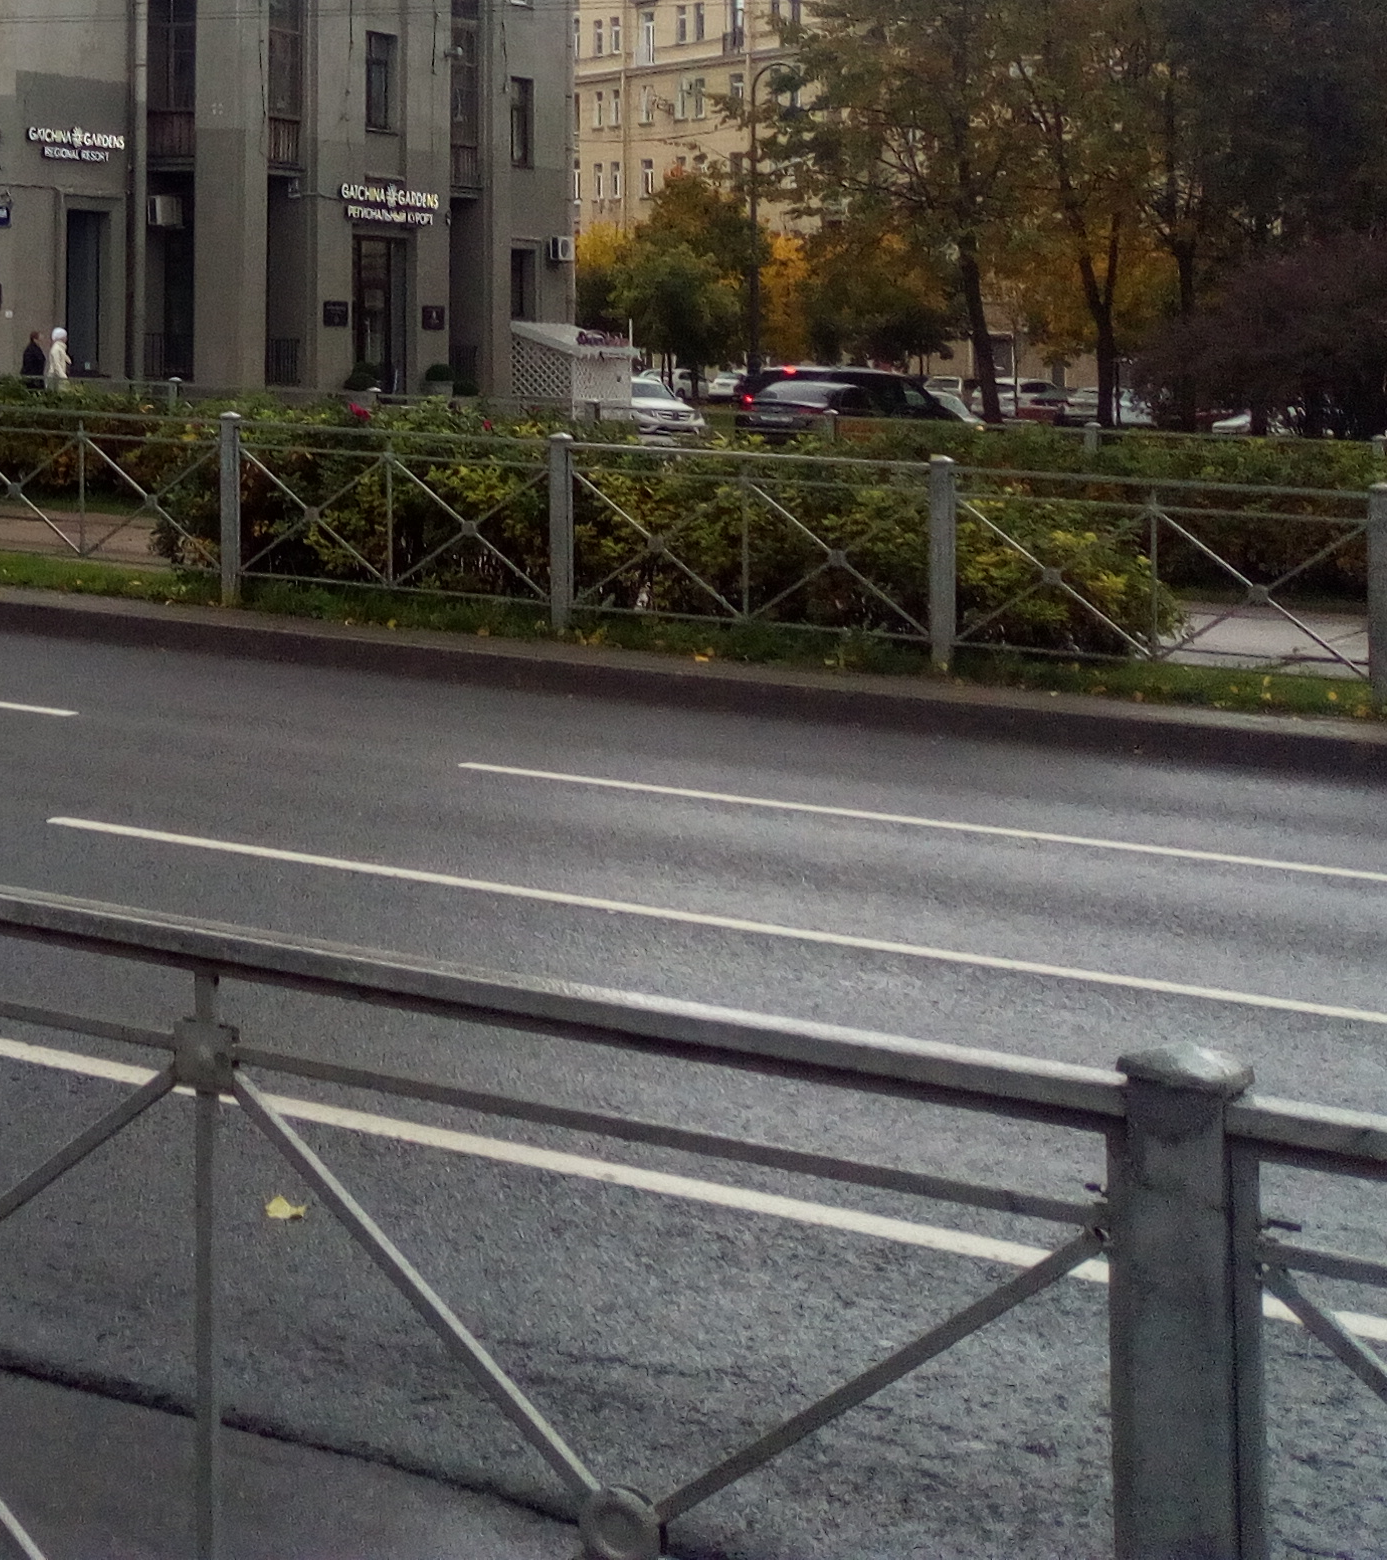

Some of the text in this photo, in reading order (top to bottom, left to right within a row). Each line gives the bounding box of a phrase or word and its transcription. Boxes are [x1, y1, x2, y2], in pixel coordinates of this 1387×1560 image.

[28, 126, 125, 150] GATCHINA GARDENS
[44, 146, 109, 162] REGIONAL RESORT
[341, 183, 439, 210] GATCHINA GARDENS
